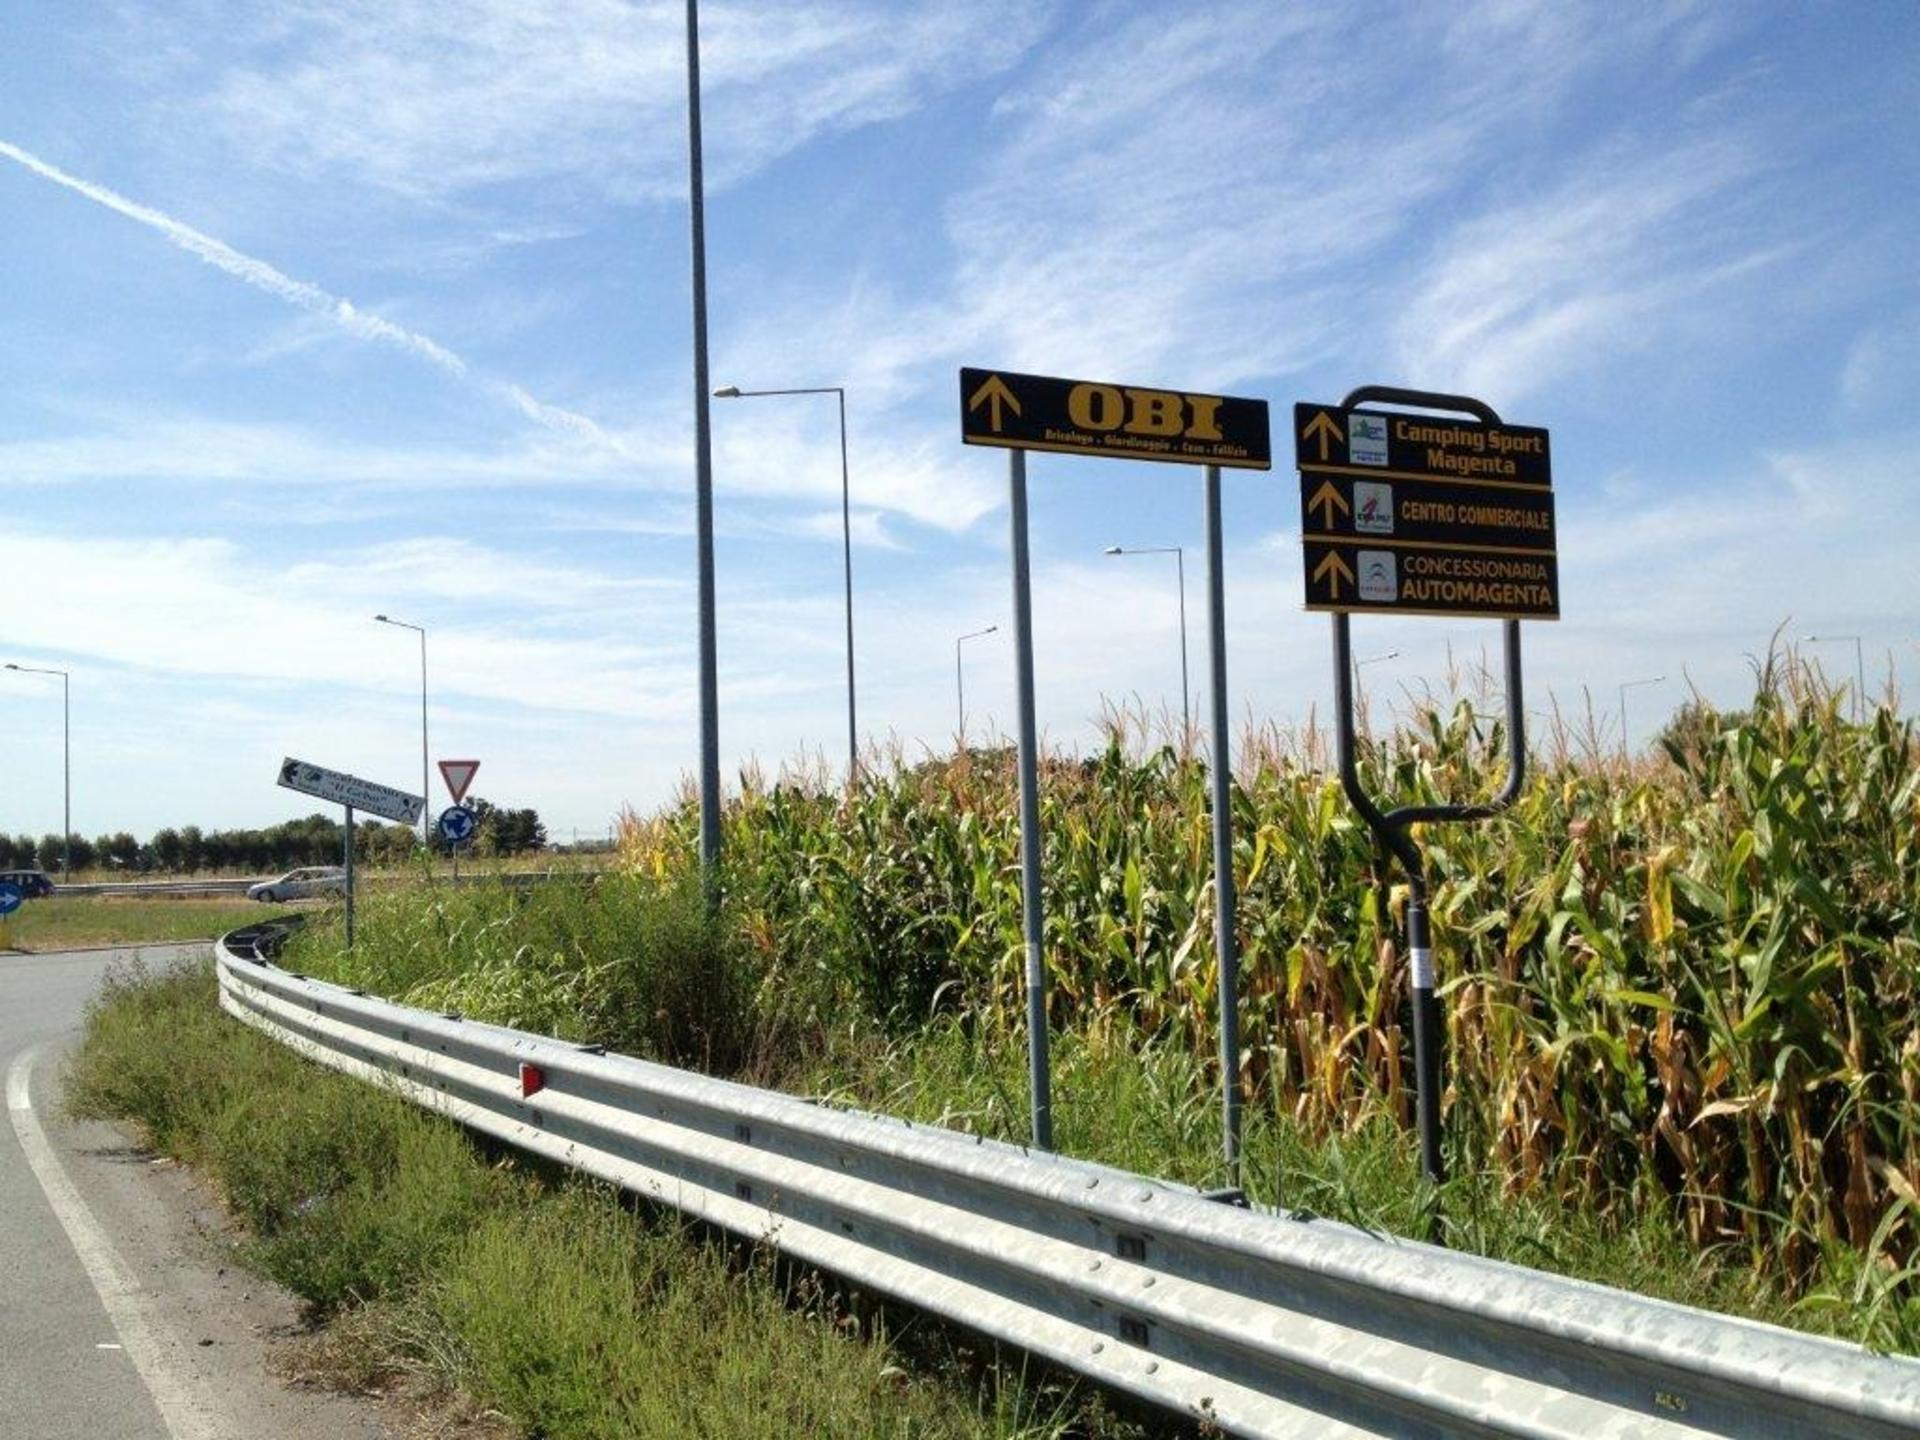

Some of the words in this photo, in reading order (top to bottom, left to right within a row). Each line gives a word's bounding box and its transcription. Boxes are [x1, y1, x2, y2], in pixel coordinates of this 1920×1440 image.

[1068, 383, 1223, 440] OBI
[1396, 421, 1485, 453] Camping
[1488, 430, 1544, 454] Sport
[1427, 450, 1516, 475] Magenta
[1402, 501, 1455, 524] CENTRO
[1458, 504, 1550, 531] COMMERCIALE
[1403, 556, 1548, 581] CONCESSIONARIA
[1402, 579, 1552, 606] AUTOMAGENTA
